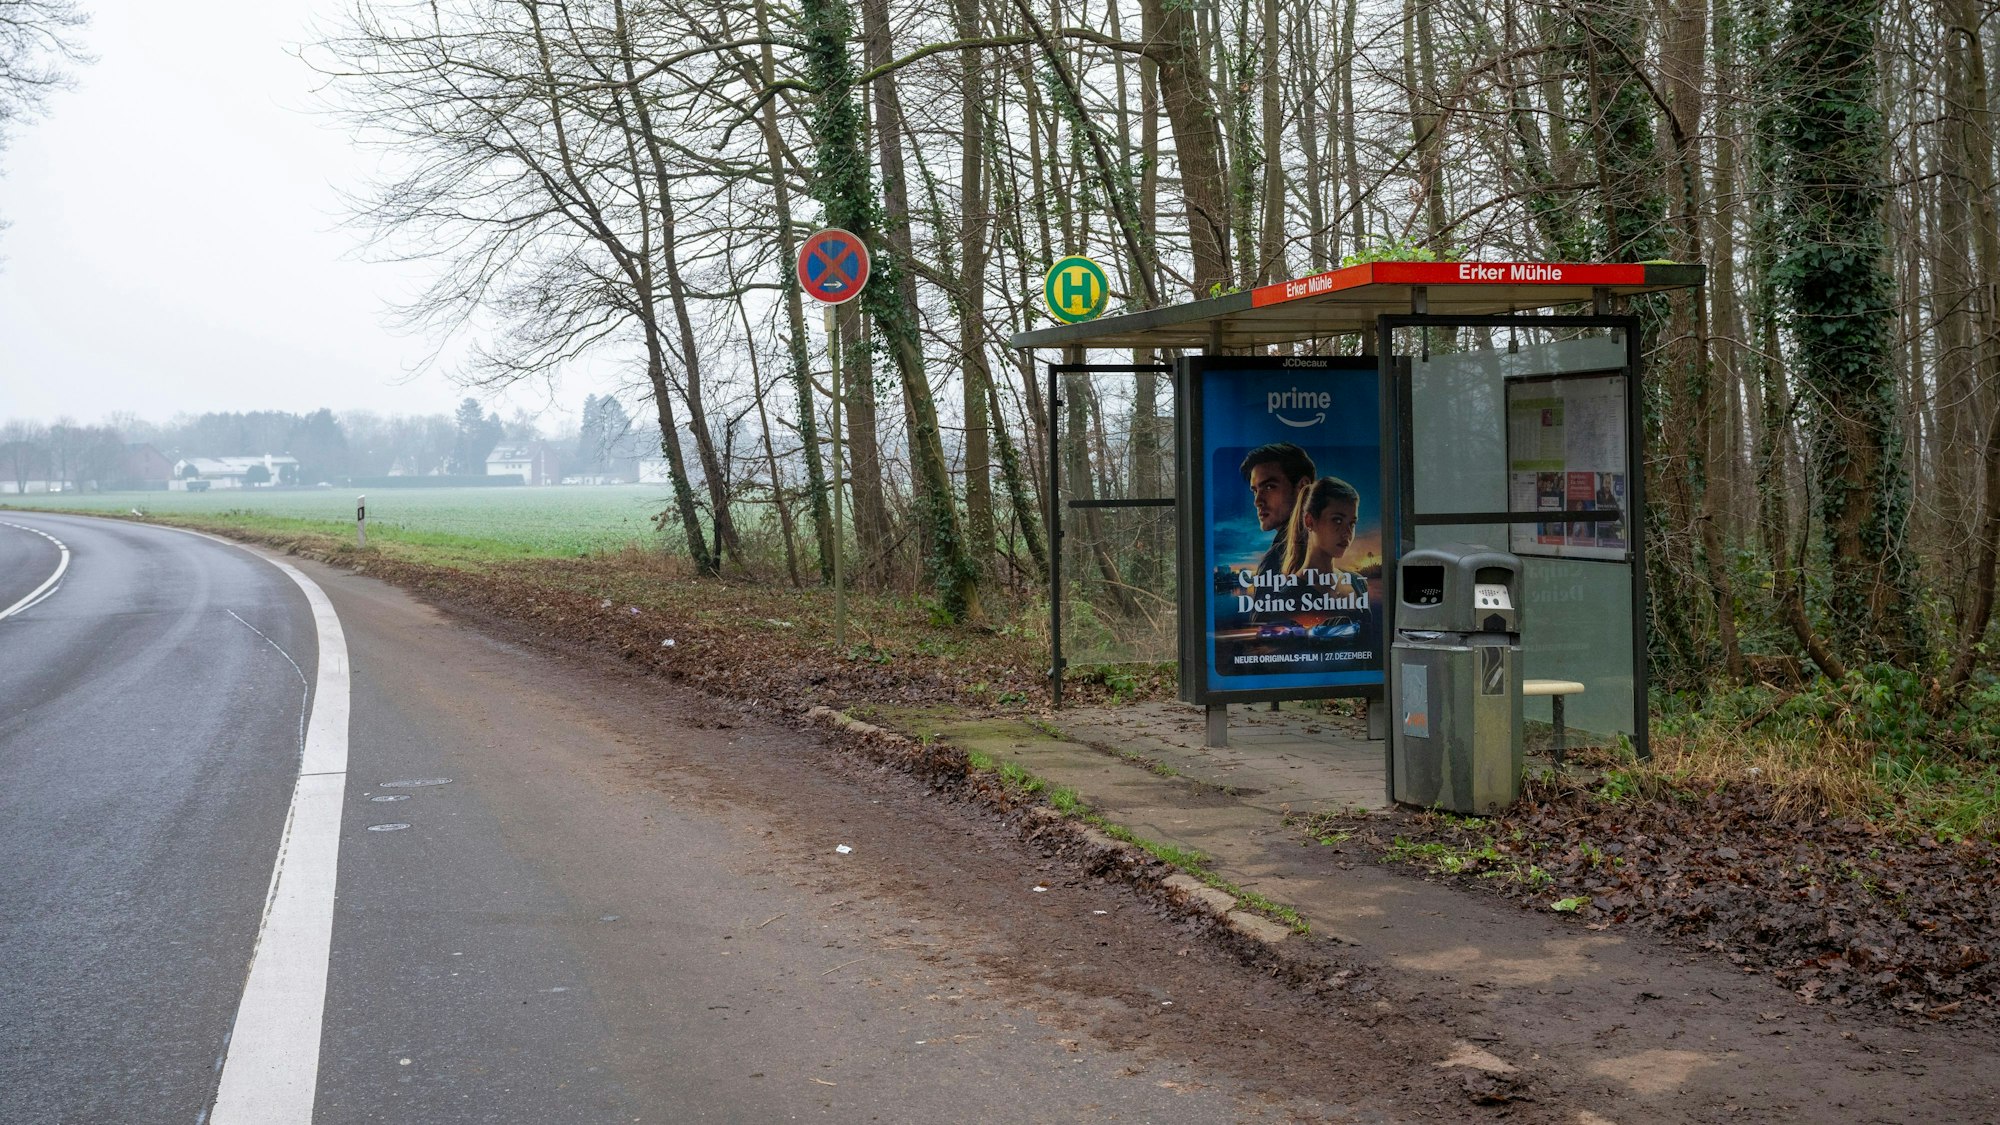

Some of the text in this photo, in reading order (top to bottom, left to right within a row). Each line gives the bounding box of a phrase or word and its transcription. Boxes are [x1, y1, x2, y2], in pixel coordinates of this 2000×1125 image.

[1459, 264, 1562, 281] Erker Mühle
[1062, 272, 1091, 309] H
[1286, 276, 1333, 298] Erker Mühle
[1282, 358, 1328, 368] JCDecaux
[1267, 386, 1331, 414] prime
[1238, 568, 1299, 593] Culpa
[1302, 568, 1352, 591] Tuya
[1238, 591, 1369, 613] Deine Schuld
[1234, 655, 1259, 664] NEUER
[1259, 653, 1319, 664] ORIGINALS-FILM
[1335, 651, 1373, 661] DEZEMBER
